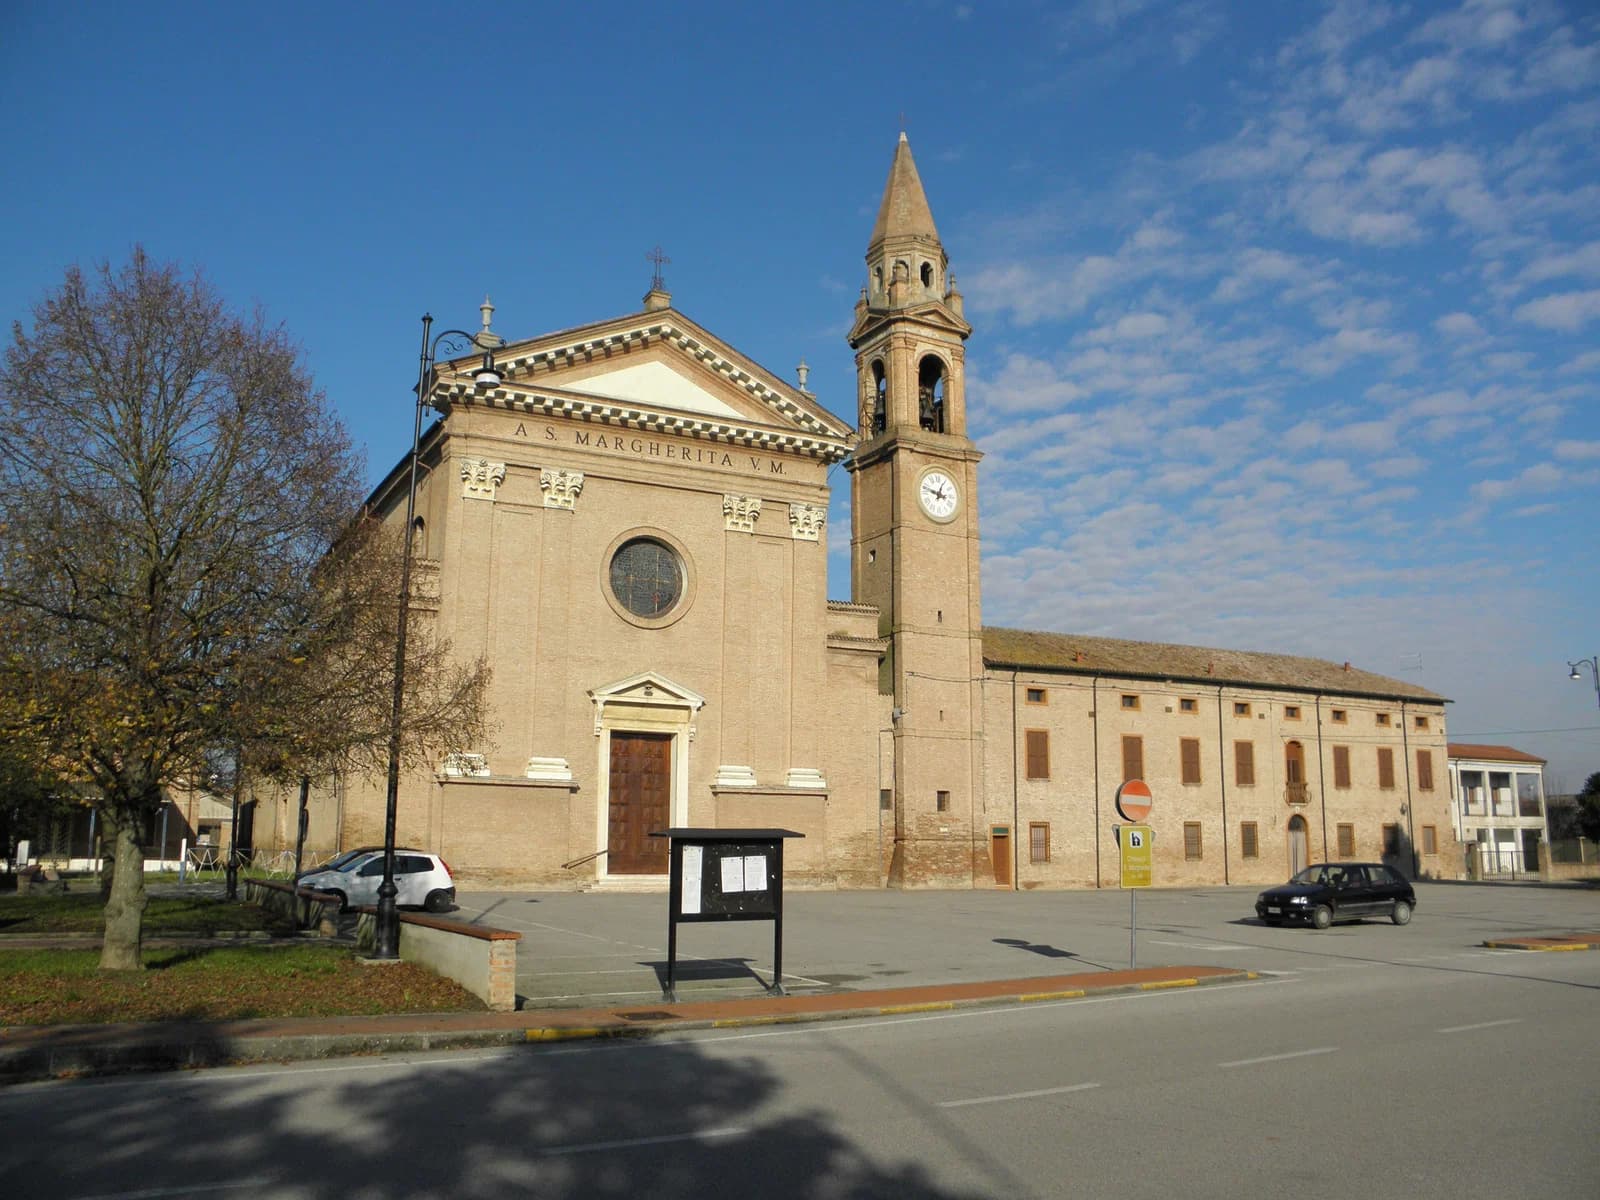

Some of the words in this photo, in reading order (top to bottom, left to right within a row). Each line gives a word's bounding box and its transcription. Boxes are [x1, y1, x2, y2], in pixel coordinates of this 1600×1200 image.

[515, 423, 528, 436] A
[545, 427, 557, 441] S.
[575, 431, 733, 466] MARGHERITA
